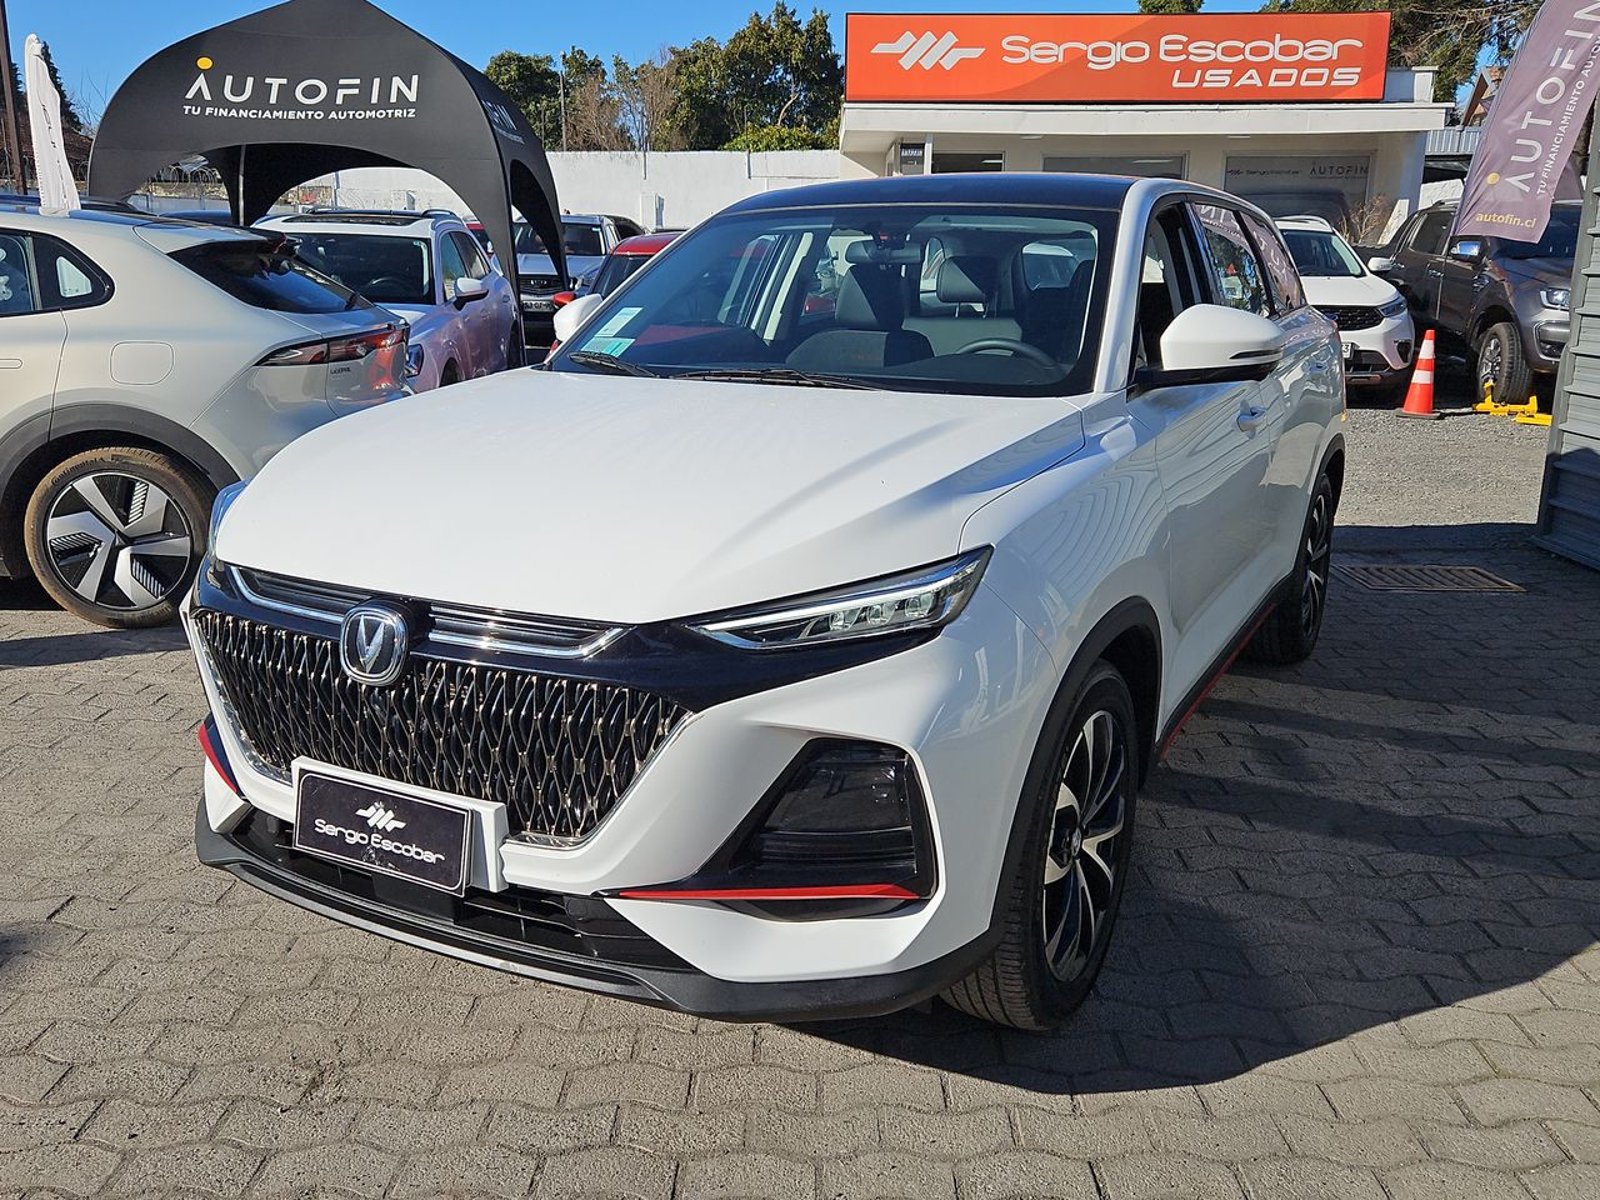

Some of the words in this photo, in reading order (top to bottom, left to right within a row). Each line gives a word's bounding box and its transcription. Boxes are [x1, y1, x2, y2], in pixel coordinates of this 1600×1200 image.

[1002, 35, 1151, 70] Sergio
[1159, 33, 1364, 62] Escobar
[185, 72, 419, 105] AUTOFIN
[1172, 67, 1362, 88] USADOS
[183, 105, 201, 115] TU
[205, 107, 324, 120] FINANCIAMIENTO
[328, 108, 416, 120] AUTOMOTRIZ
[1537, 179, 1547, 196] TU
[1543, 80, 1585, 178] FINANCIAMIENTO
[1309, 164, 1369, 176] AUTOFIN
[1476, 212, 1537, 229] autofin.cl
[314, 818, 369, 845] Sergio
[370, 833, 446, 864] Escobar
